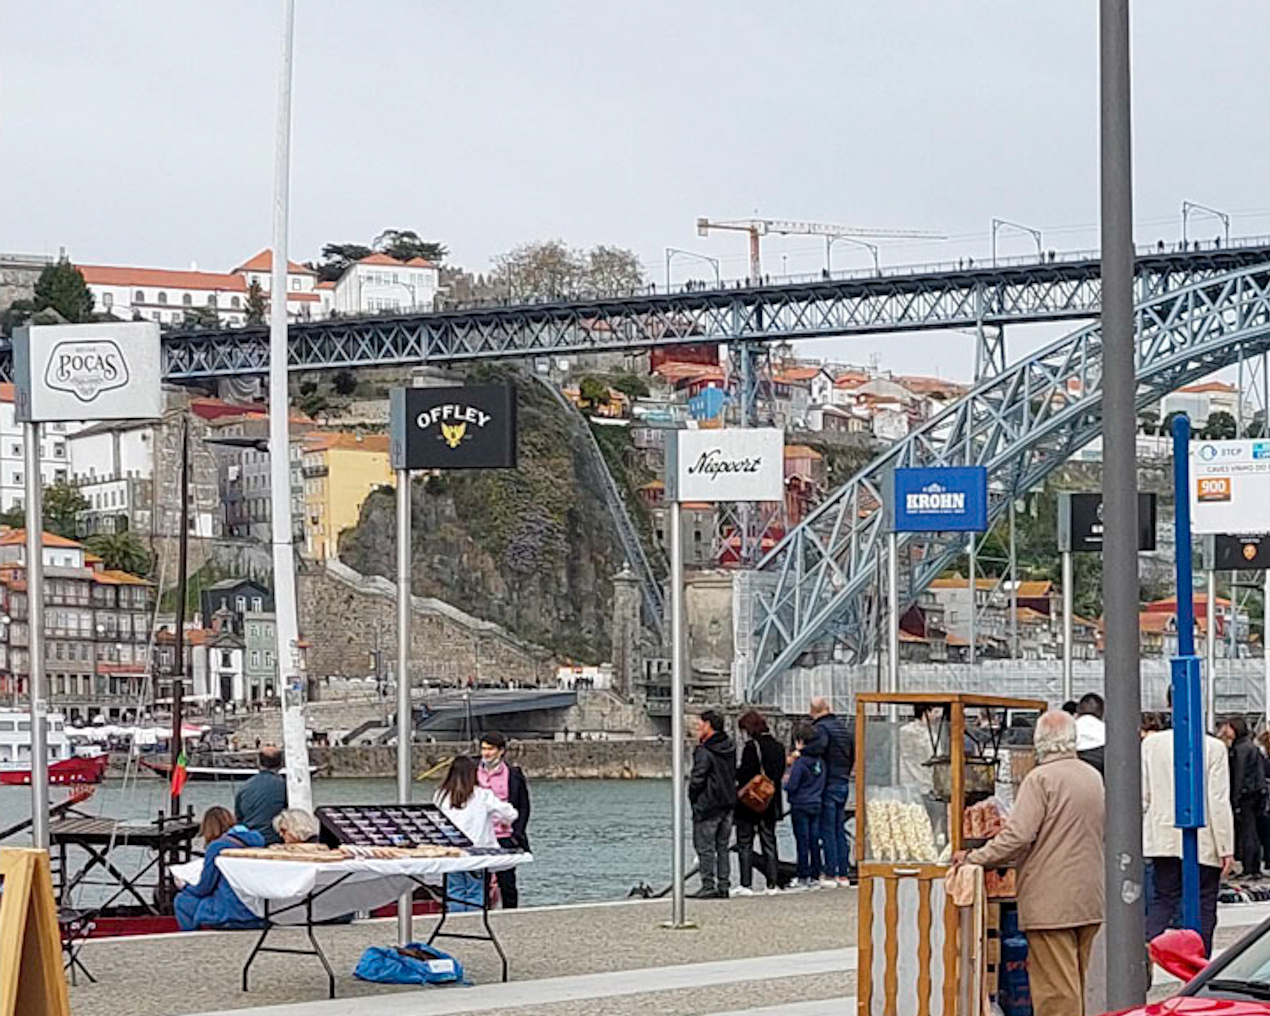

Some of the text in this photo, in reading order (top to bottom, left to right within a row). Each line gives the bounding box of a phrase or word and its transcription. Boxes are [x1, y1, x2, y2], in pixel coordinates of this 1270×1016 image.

[417, 405, 492, 428] OFFLEY
[688, 449, 762, 481] Niepoort
[1201, 480, 1227, 493] 900
[906, 492, 966, 509] KROHN
